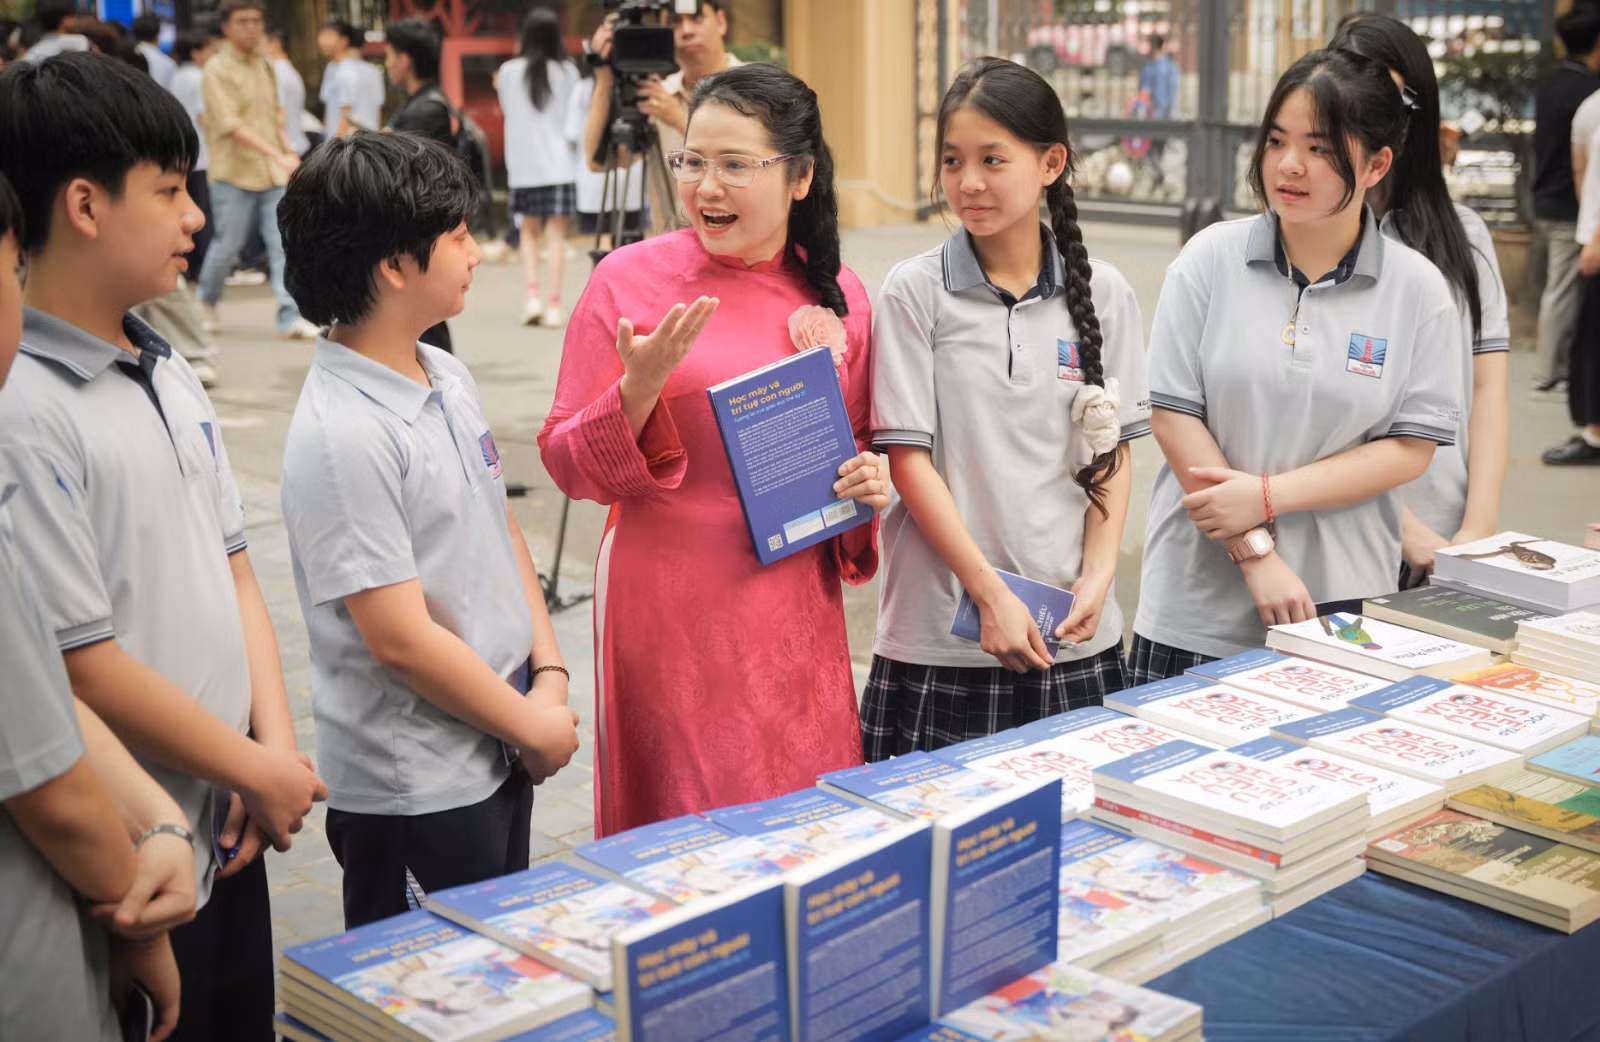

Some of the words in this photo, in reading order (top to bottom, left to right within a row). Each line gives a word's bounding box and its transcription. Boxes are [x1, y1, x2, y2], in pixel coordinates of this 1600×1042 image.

[728, 395, 747, 406] Học
[748, 386, 767, 399] máy
[769, 381, 780, 391] và
[731, 406, 743, 416] trí
[760, 393, 777, 404] con
